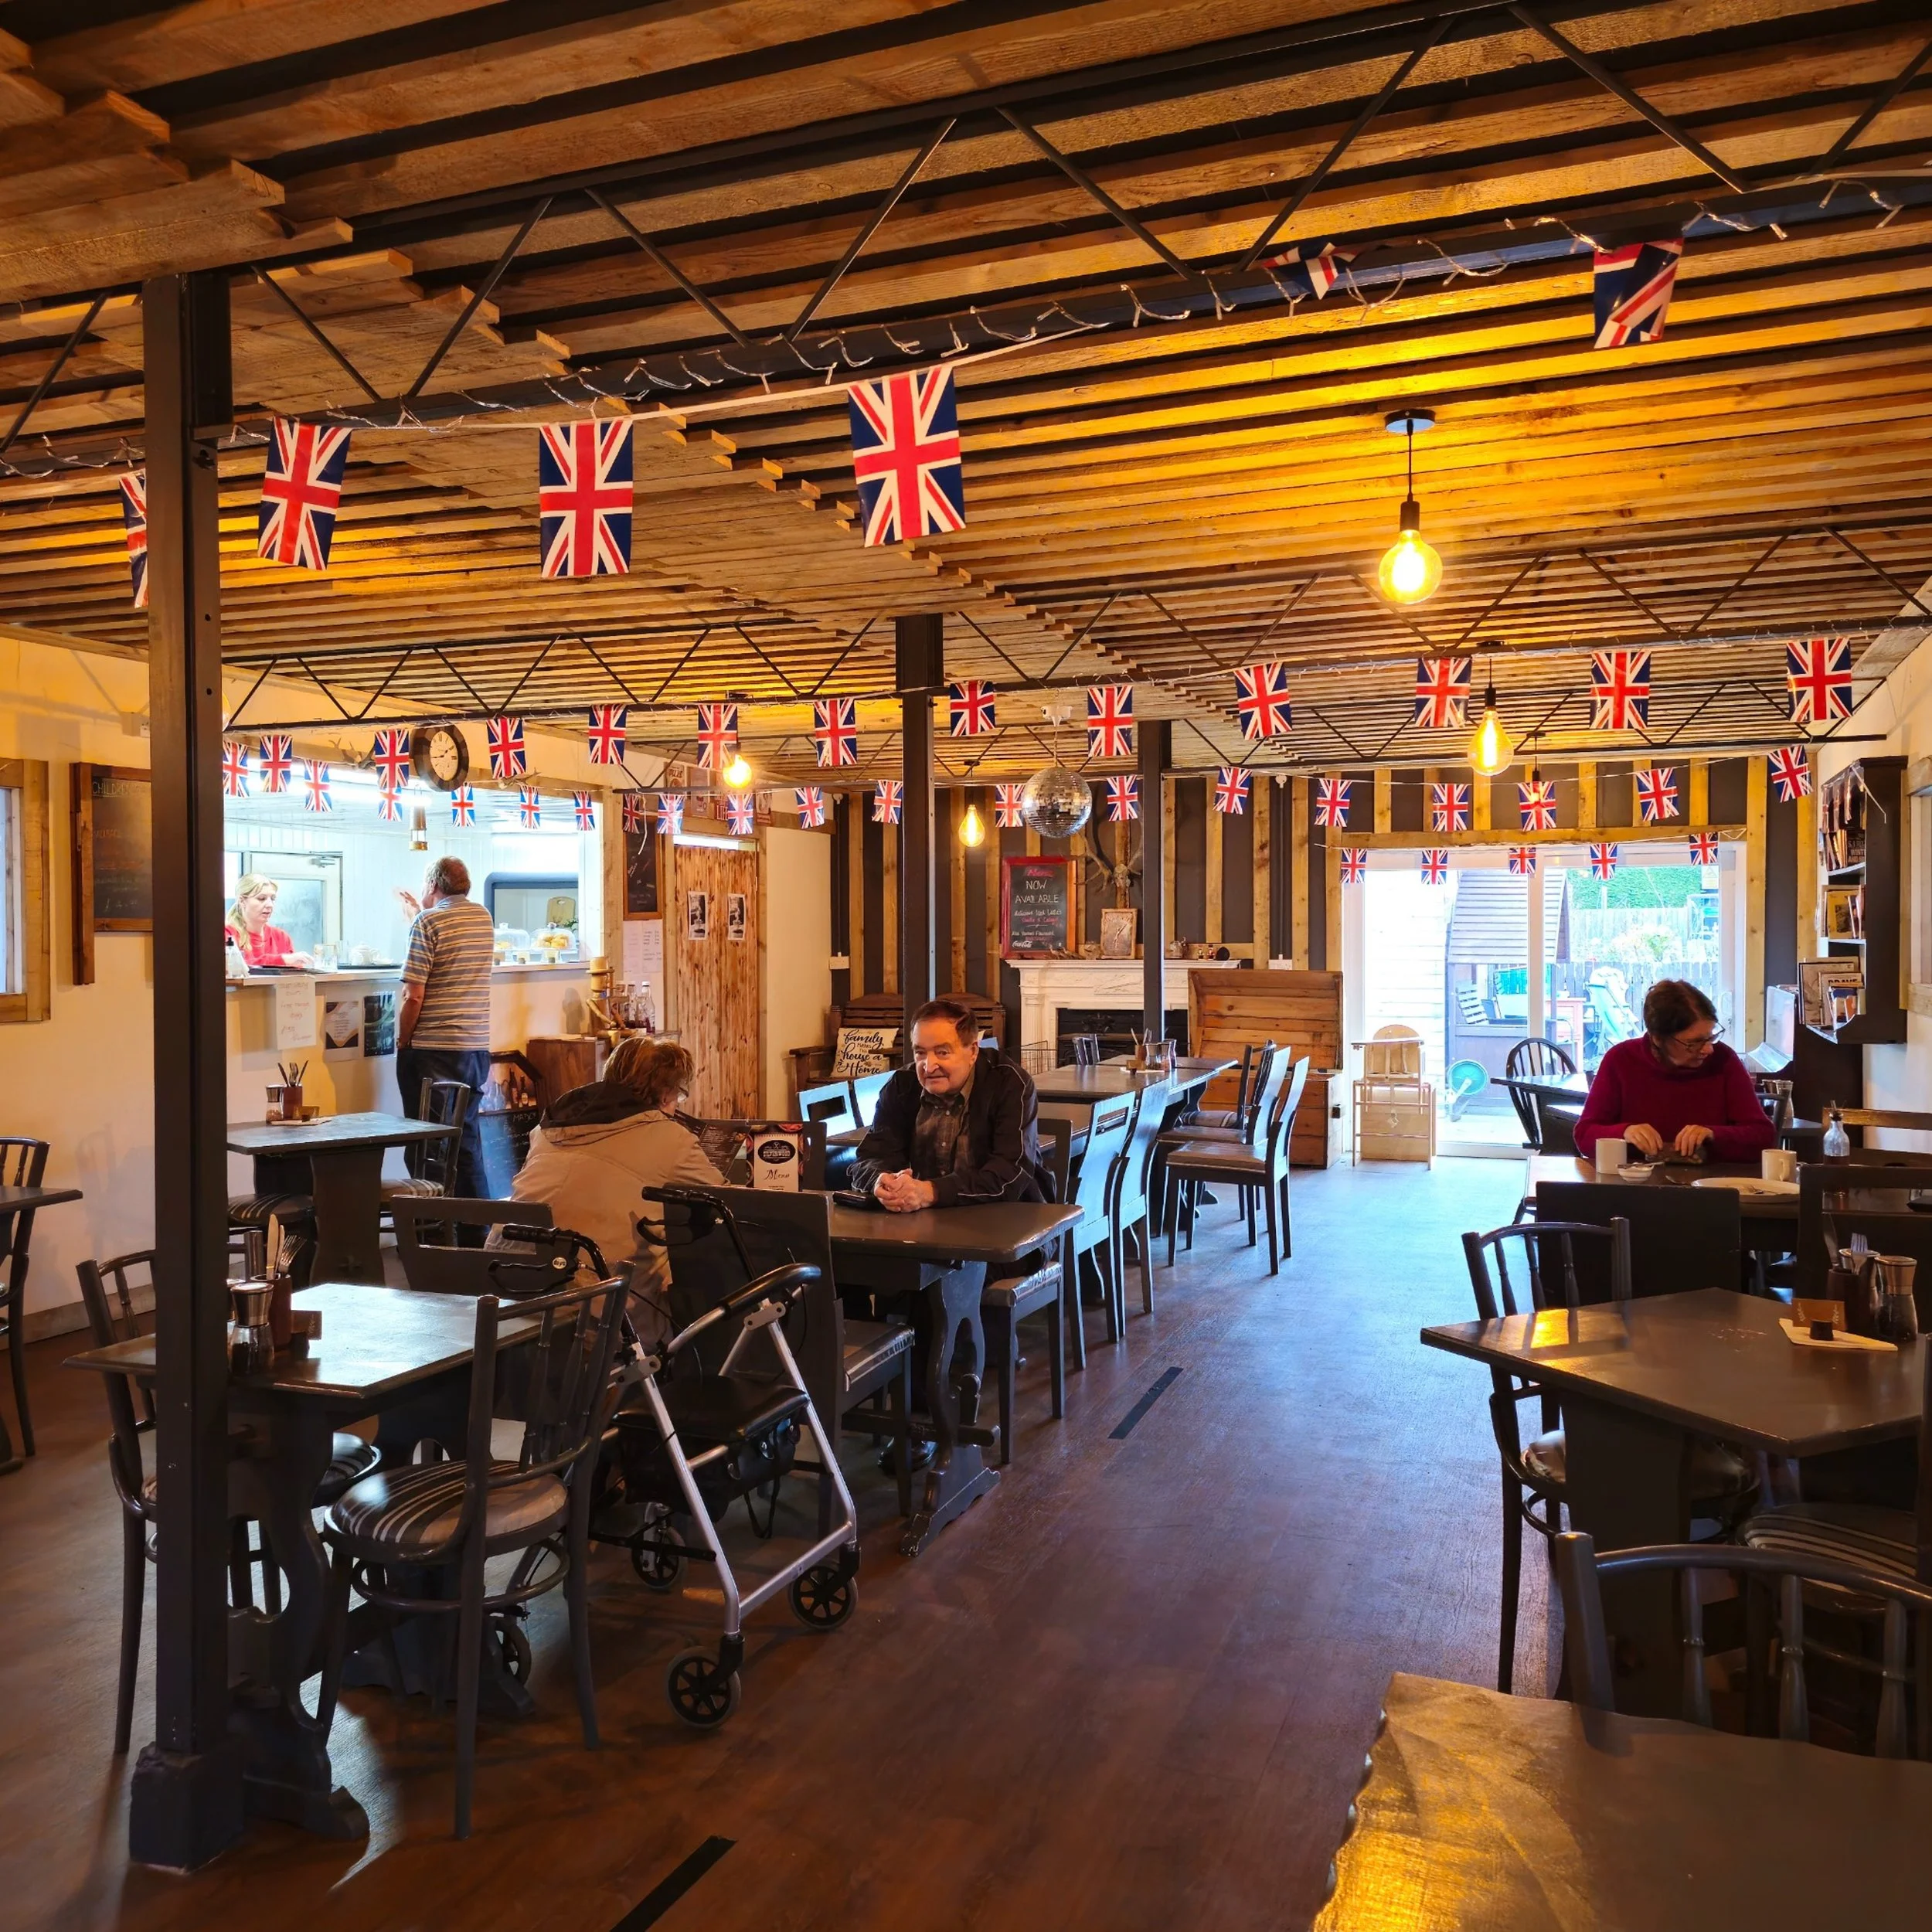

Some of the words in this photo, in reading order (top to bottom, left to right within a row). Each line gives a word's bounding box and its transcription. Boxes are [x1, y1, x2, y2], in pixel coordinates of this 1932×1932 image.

[1026, 879, 1047, 890] NOW
[1015, 894, 1060, 904] AVAILABLE
[841, 1043, 870, 1063] house
[837, 1060, 881, 1077] Home
[764, 1168, 790, 1180] Menu
